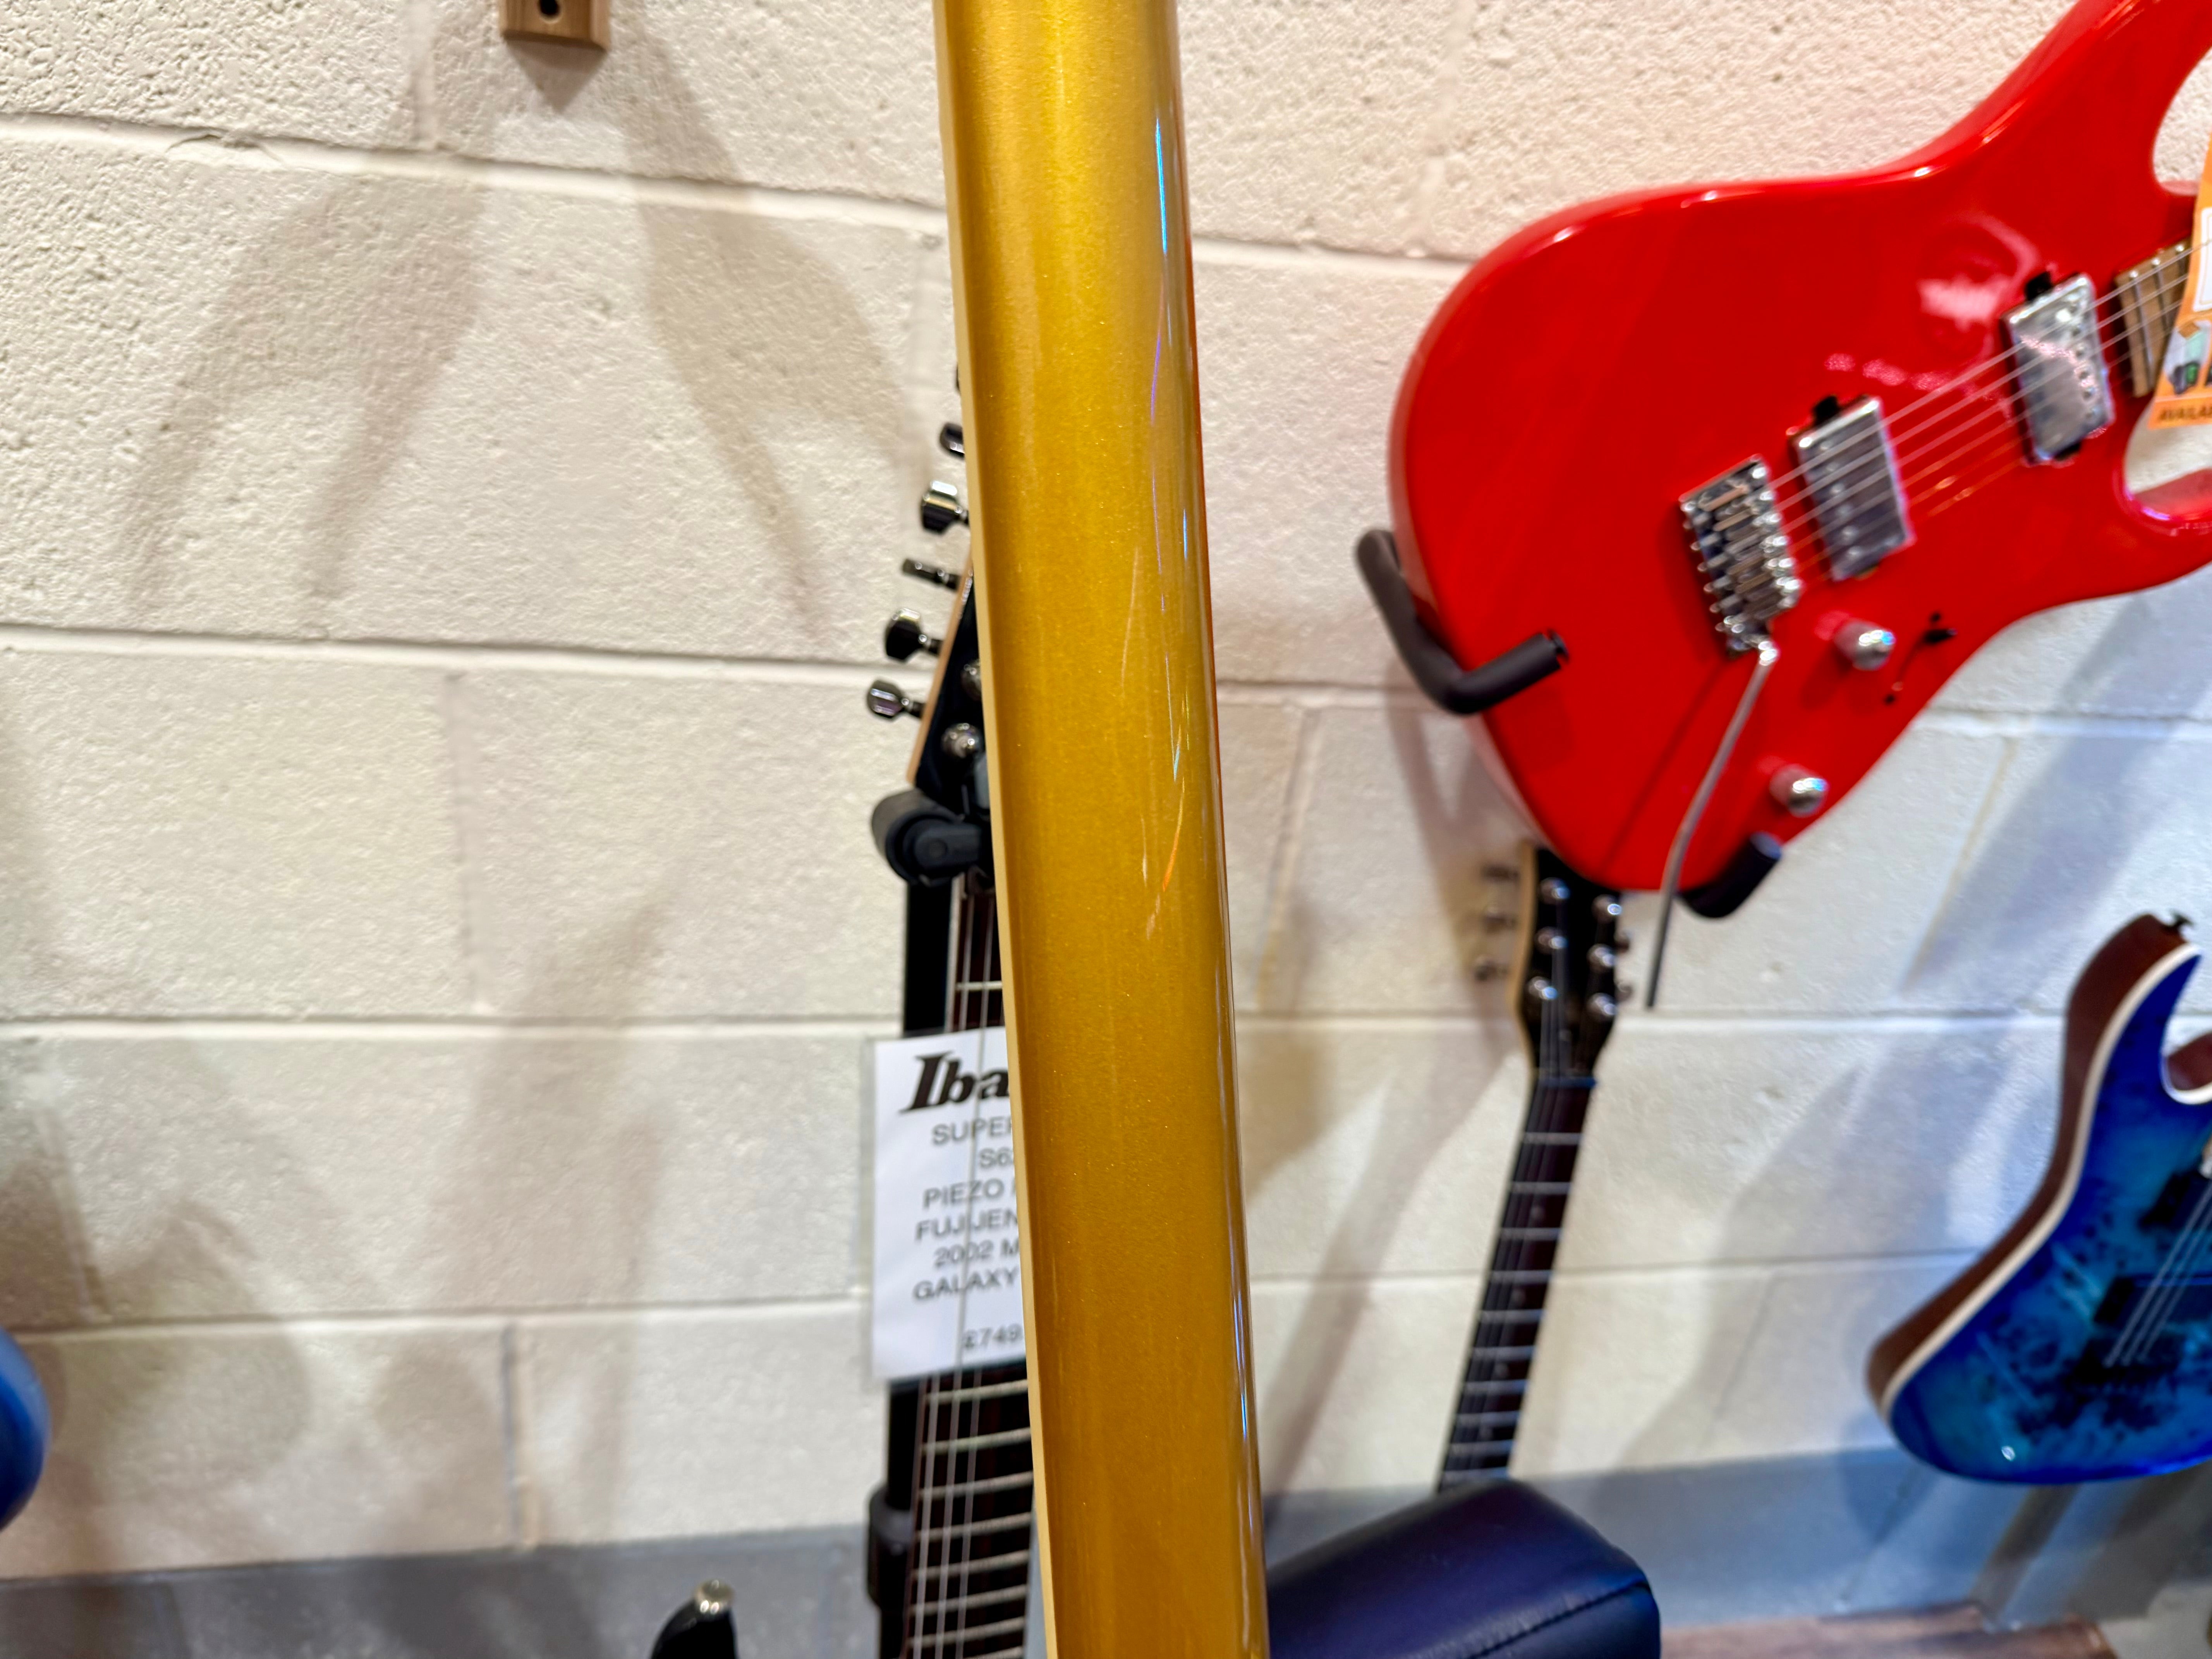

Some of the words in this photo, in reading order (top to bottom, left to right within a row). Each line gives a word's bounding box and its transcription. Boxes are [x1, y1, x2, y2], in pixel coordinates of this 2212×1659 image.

[932, 1116, 1012, 1145] SUPE
[980, 1147, 1014, 1169] S6
[923, 1178, 1005, 1209] PIEZO
[933, 1239, 994, 1269] 2002
[912, 1265, 1019, 1302] GALAXY
